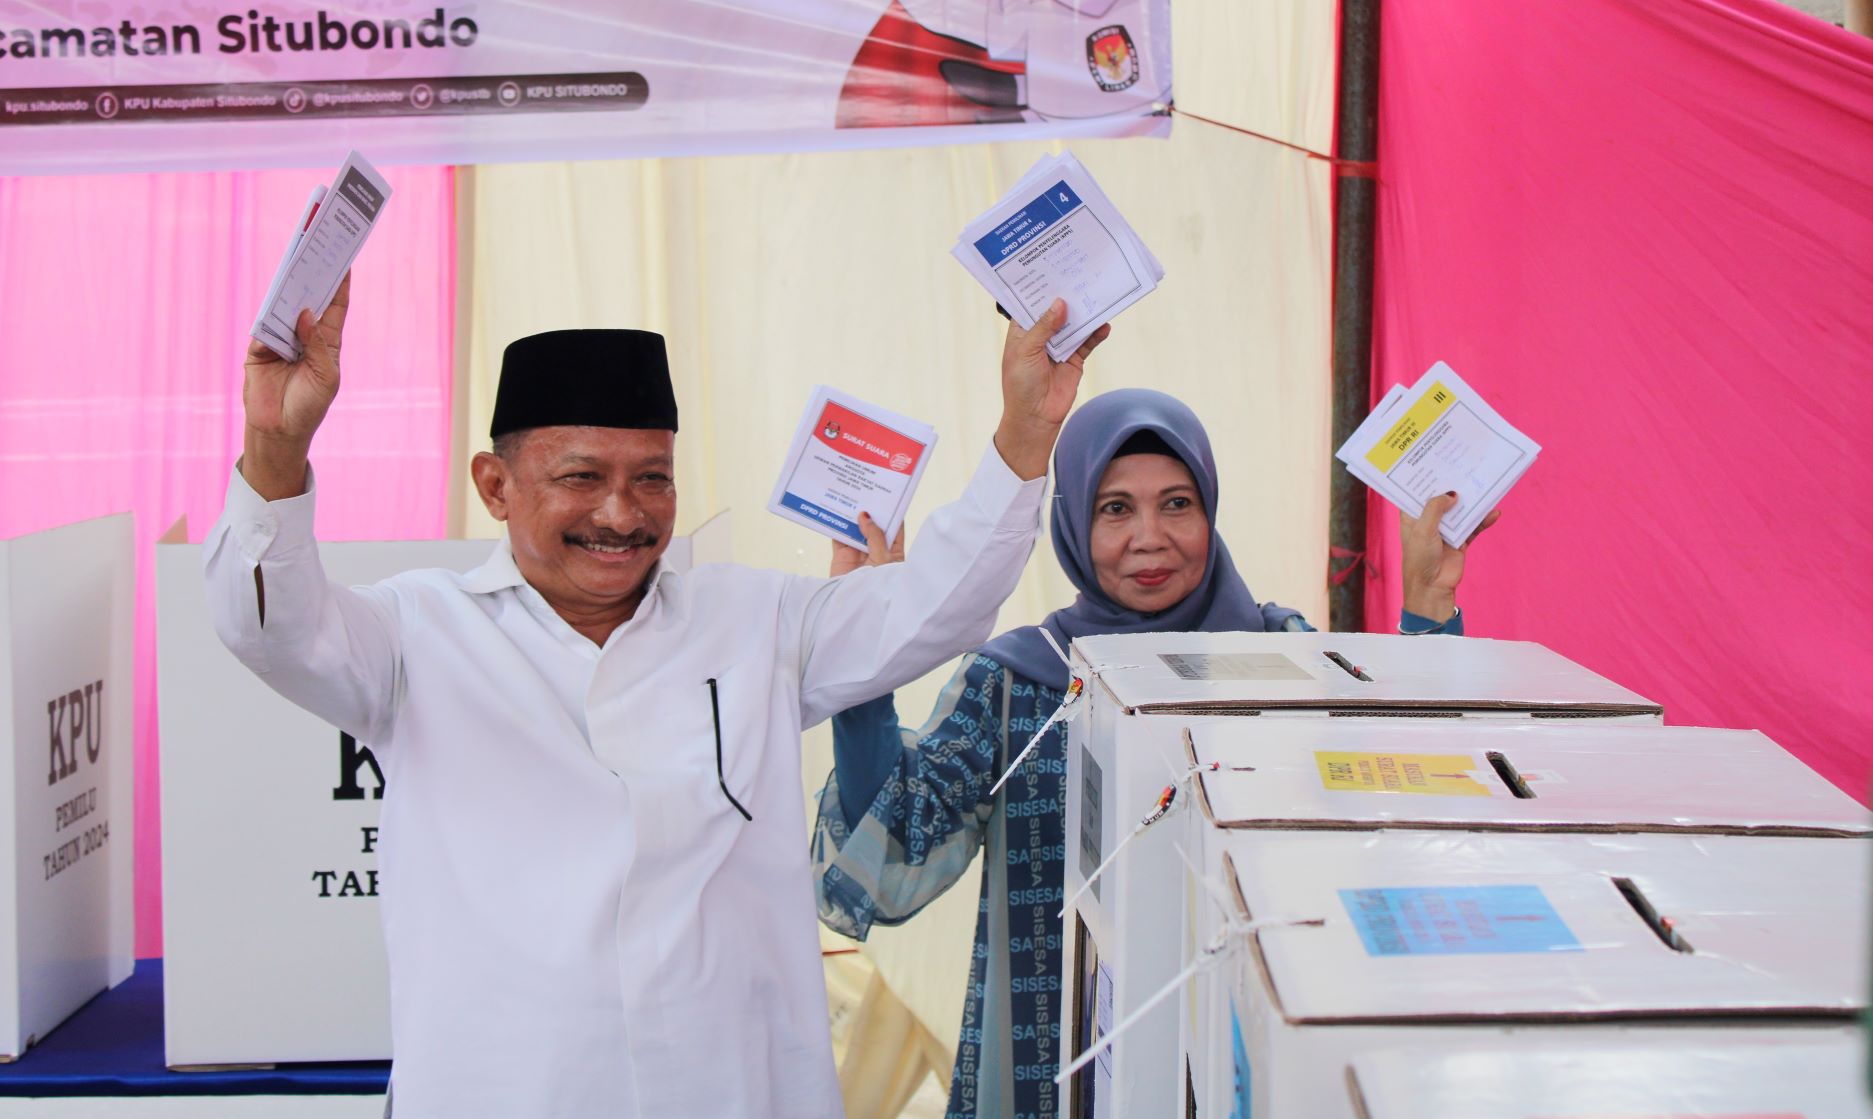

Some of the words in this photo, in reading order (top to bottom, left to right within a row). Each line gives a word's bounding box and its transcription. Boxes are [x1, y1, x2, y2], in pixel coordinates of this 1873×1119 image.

[0, 20, 200, 58] amatan
[217, 8, 478, 53] Situbondo
[124, 98, 149, 109] KPU
[152, 96, 214, 110] Kabupaten
[216, 94, 277, 107] Situbondo
[526, 86, 553, 98] KPU
[554, 83, 628, 97] SITUBONDO
[1058, 191, 1070, 204] 4
[1000, 241, 1018, 255] DPRD
[1016, 220, 1046, 243] PROVINSI
[1013, 220, 1028, 233] TIMUR
[1433, 391, 1447, 404] III
[842, 432, 865, 447] SURAT
[865, 443, 890, 459] SUARA
[1398, 436, 1412, 450] DPR
[1410, 429, 1419, 437] RI
[799, 503, 818, 515] DPRD
[818, 512, 848, 529] PROVINSI
[47, 680, 103, 786] KPU
[55, 787, 97, 833] PEMILU
[1006, 799, 1060, 818] SISESA
[910, 796, 925, 866] SISESA
[43, 836, 82, 881] TAHUN
[83, 820, 110, 857] 2024
[1009, 887, 1064, 906] SISESA
[1033, 905, 1047, 975] SISESA
[1011, 975, 1062, 993] SISES
[1036, 993, 1051, 1063] SISESA
[961, 1043, 976, 1112] SISESA
